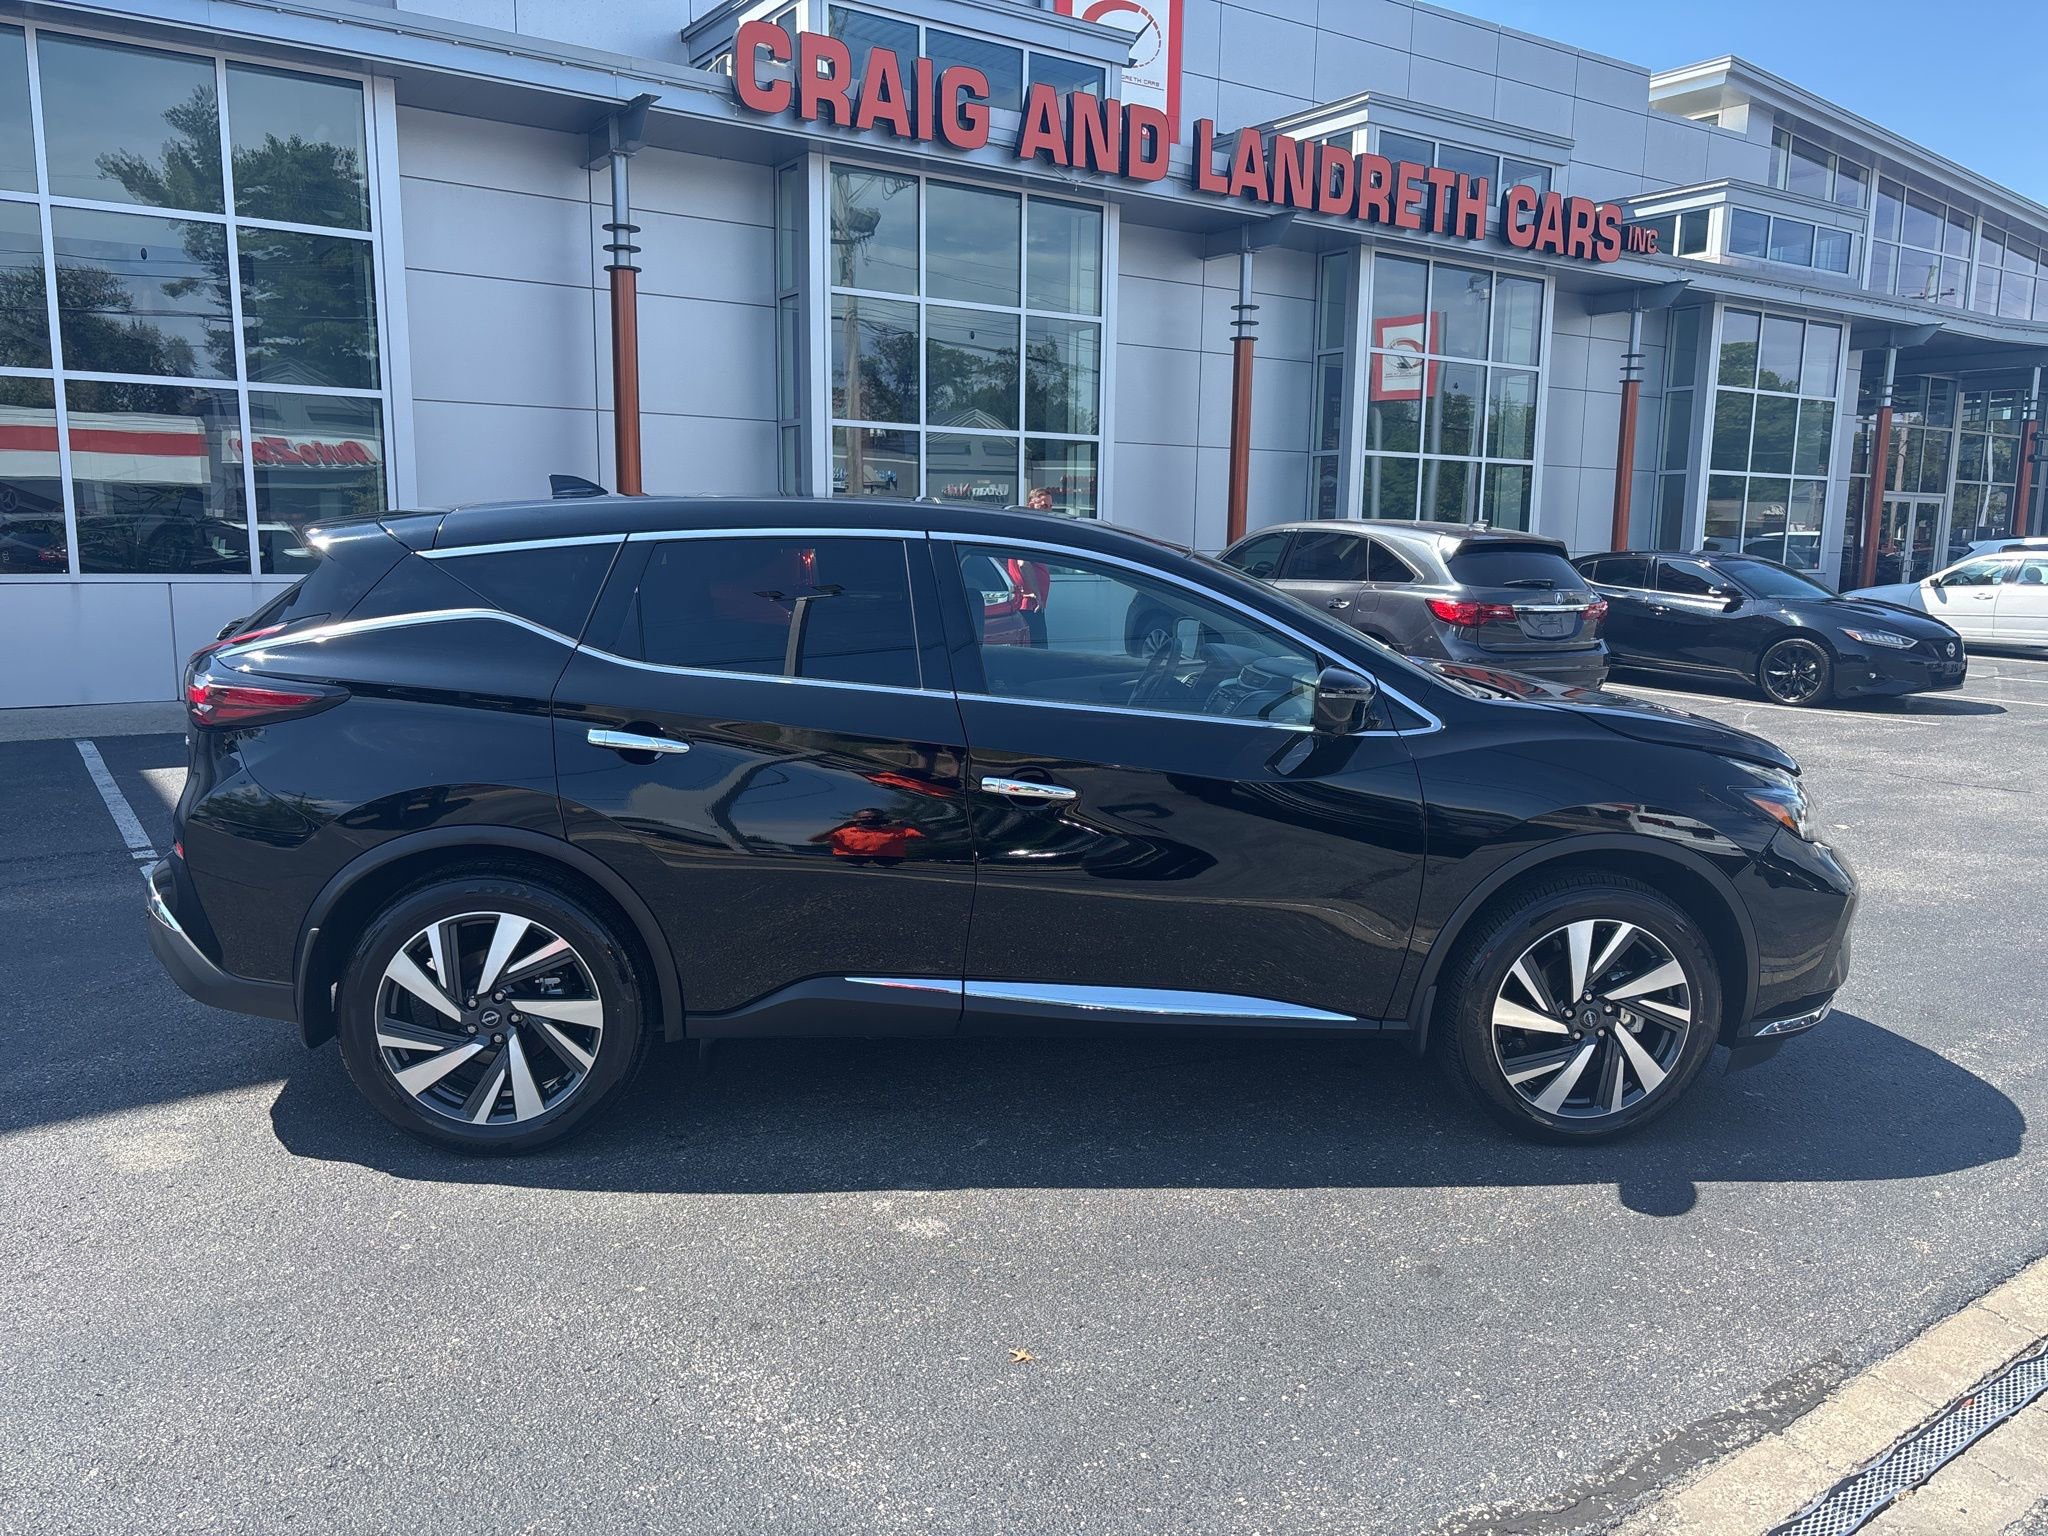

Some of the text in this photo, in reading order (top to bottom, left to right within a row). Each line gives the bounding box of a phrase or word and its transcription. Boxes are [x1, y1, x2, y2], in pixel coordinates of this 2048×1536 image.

[735, 20, 1659, 263] CRAIG AND LANDRETH CARS INC
